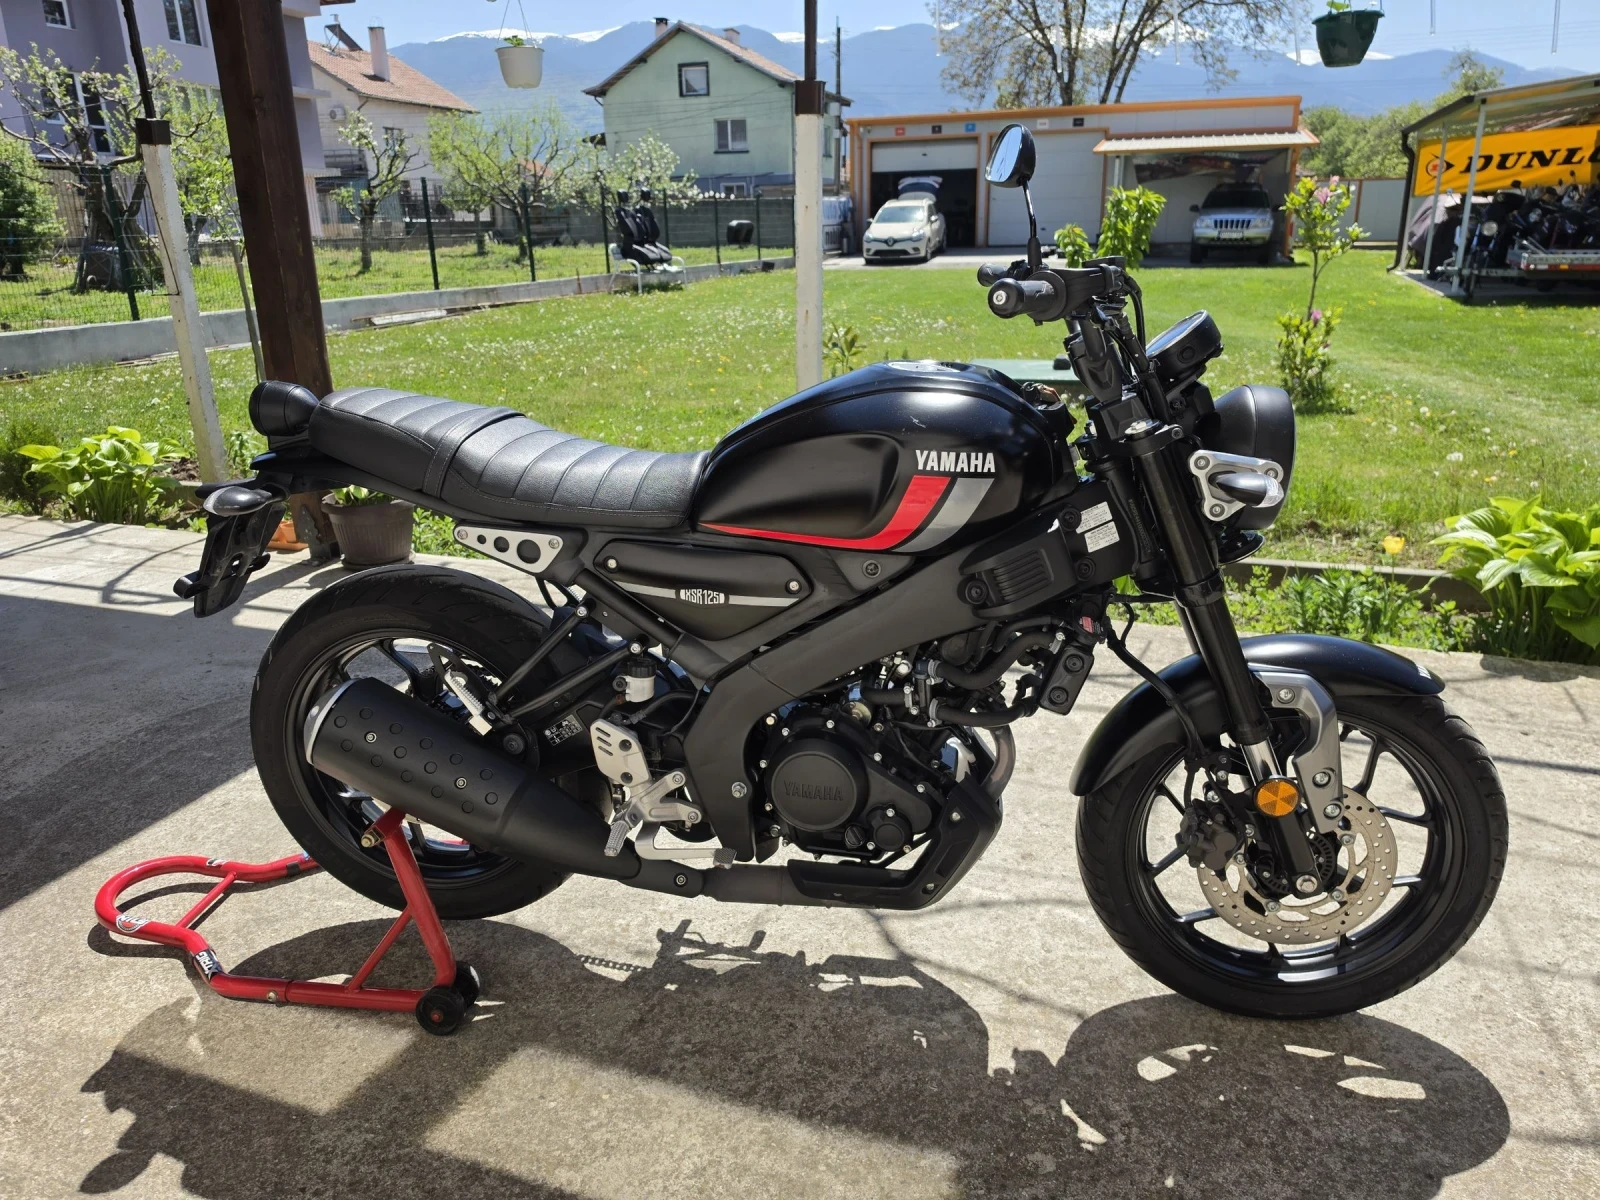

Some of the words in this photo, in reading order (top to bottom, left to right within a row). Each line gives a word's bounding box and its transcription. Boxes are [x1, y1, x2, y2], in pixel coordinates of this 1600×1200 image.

[915, 449, 996, 473] YAMAHA
[685, 588, 719, 605] XSR125
[783, 780, 844, 801] YAMAHA
